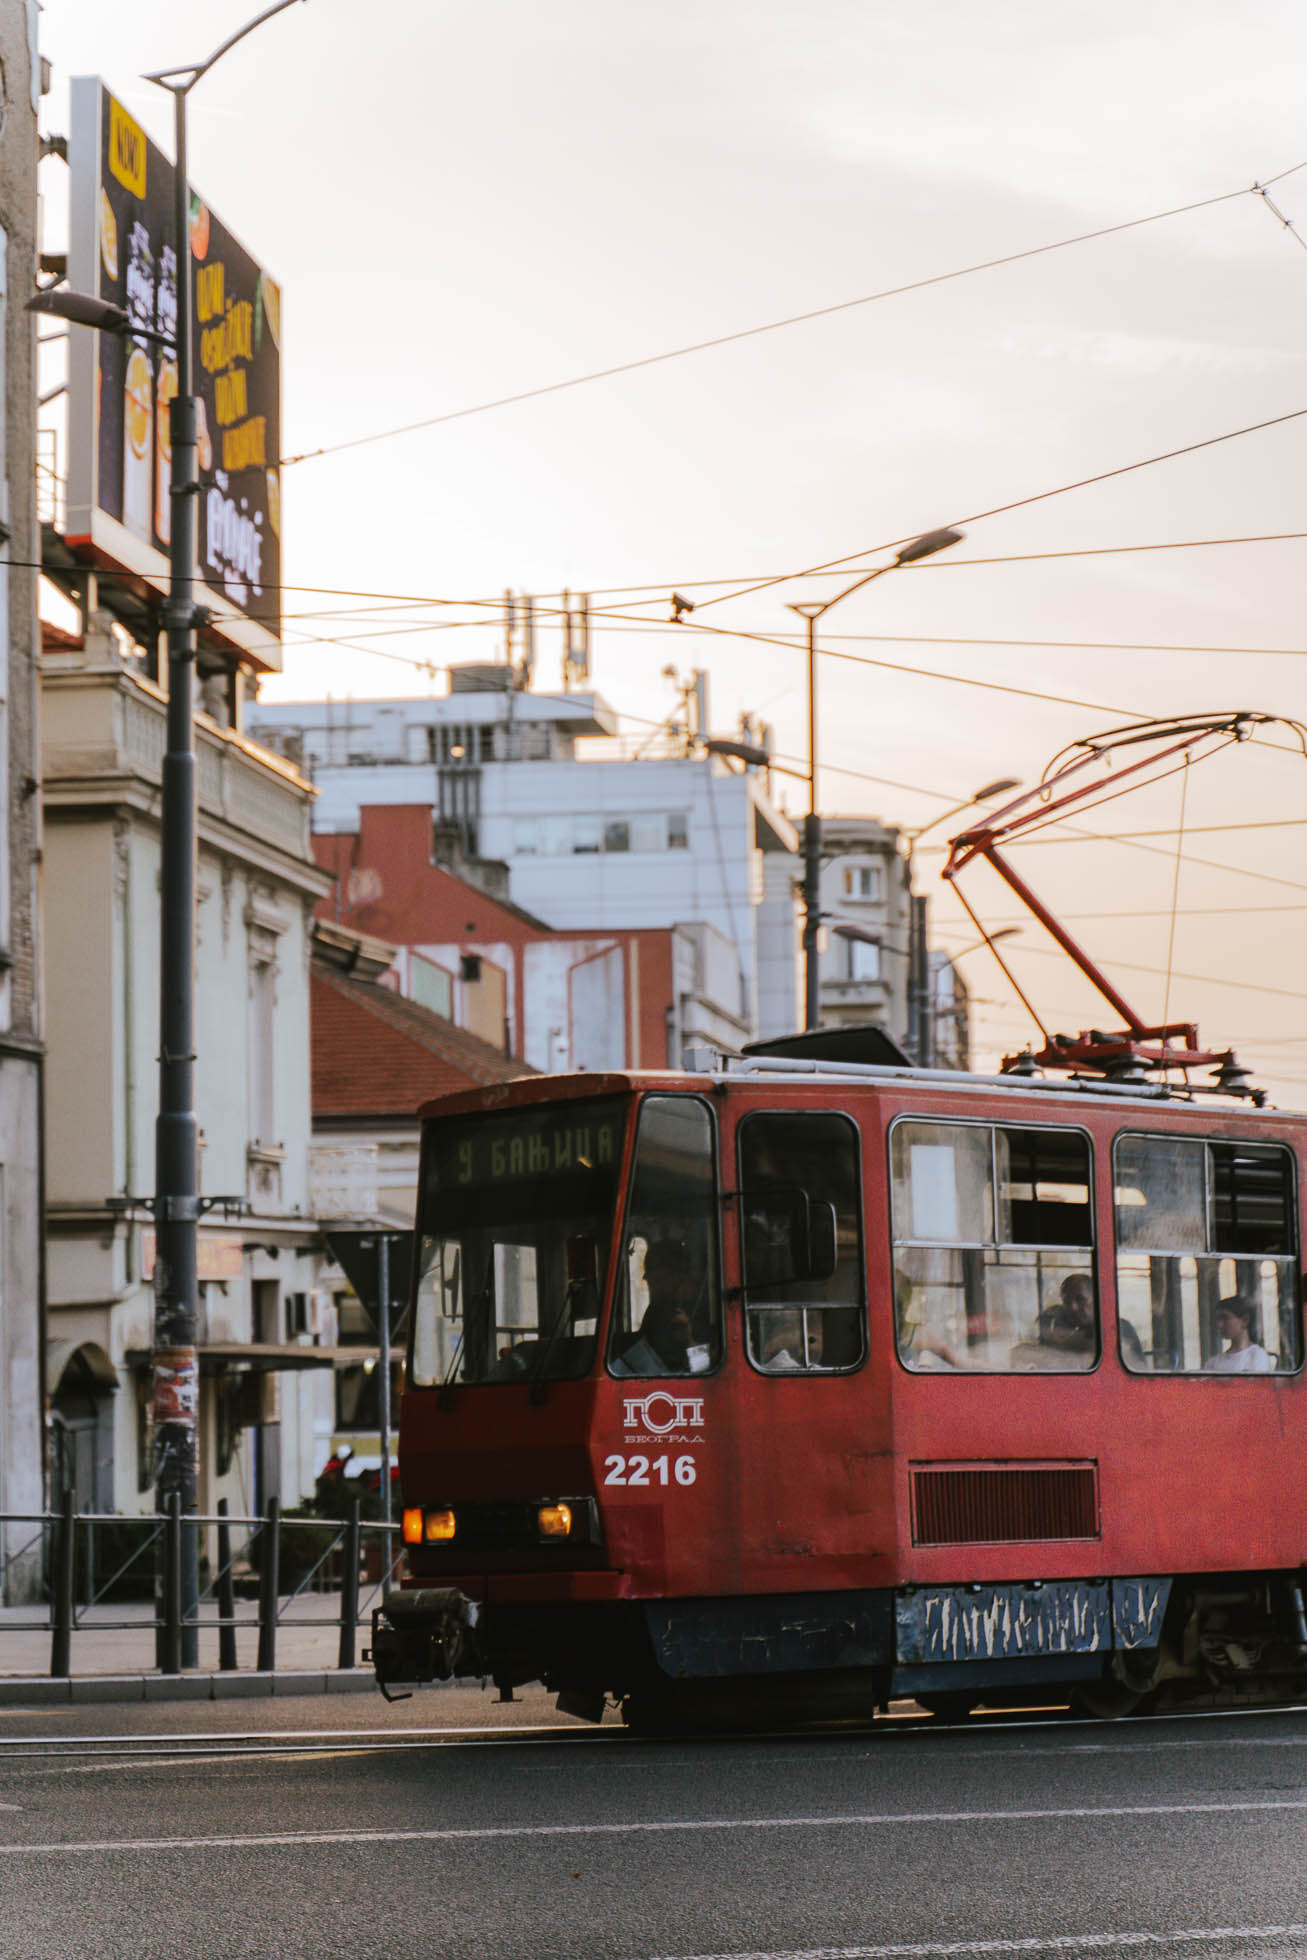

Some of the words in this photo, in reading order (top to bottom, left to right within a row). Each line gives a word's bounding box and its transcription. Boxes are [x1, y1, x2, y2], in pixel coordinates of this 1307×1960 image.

[458, 1139, 474, 1183] 9
[490, 1123, 614, 1176] БАЊИЦА
[623, 1391, 705, 1434] ГСП
[604, 1454, 697, 1486] 2216
